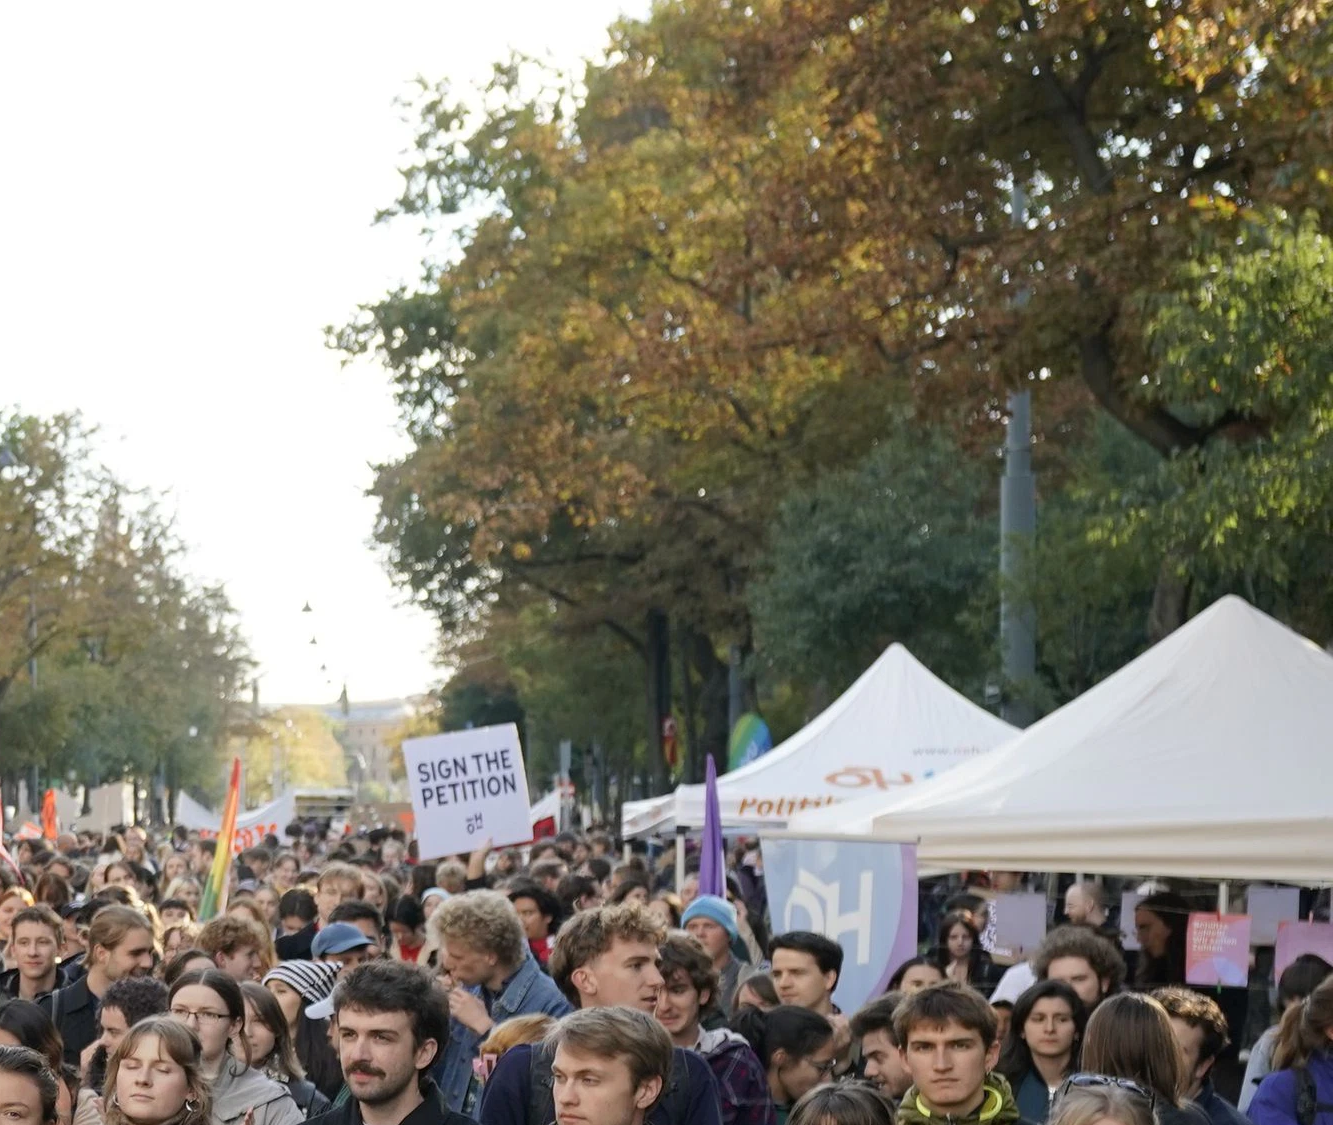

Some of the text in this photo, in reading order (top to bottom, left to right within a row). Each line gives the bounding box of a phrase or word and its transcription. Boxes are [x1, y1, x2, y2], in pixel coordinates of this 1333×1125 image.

[418, 749, 512, 783] SIGN THE
[421, 773, 517, 809] PETITION
